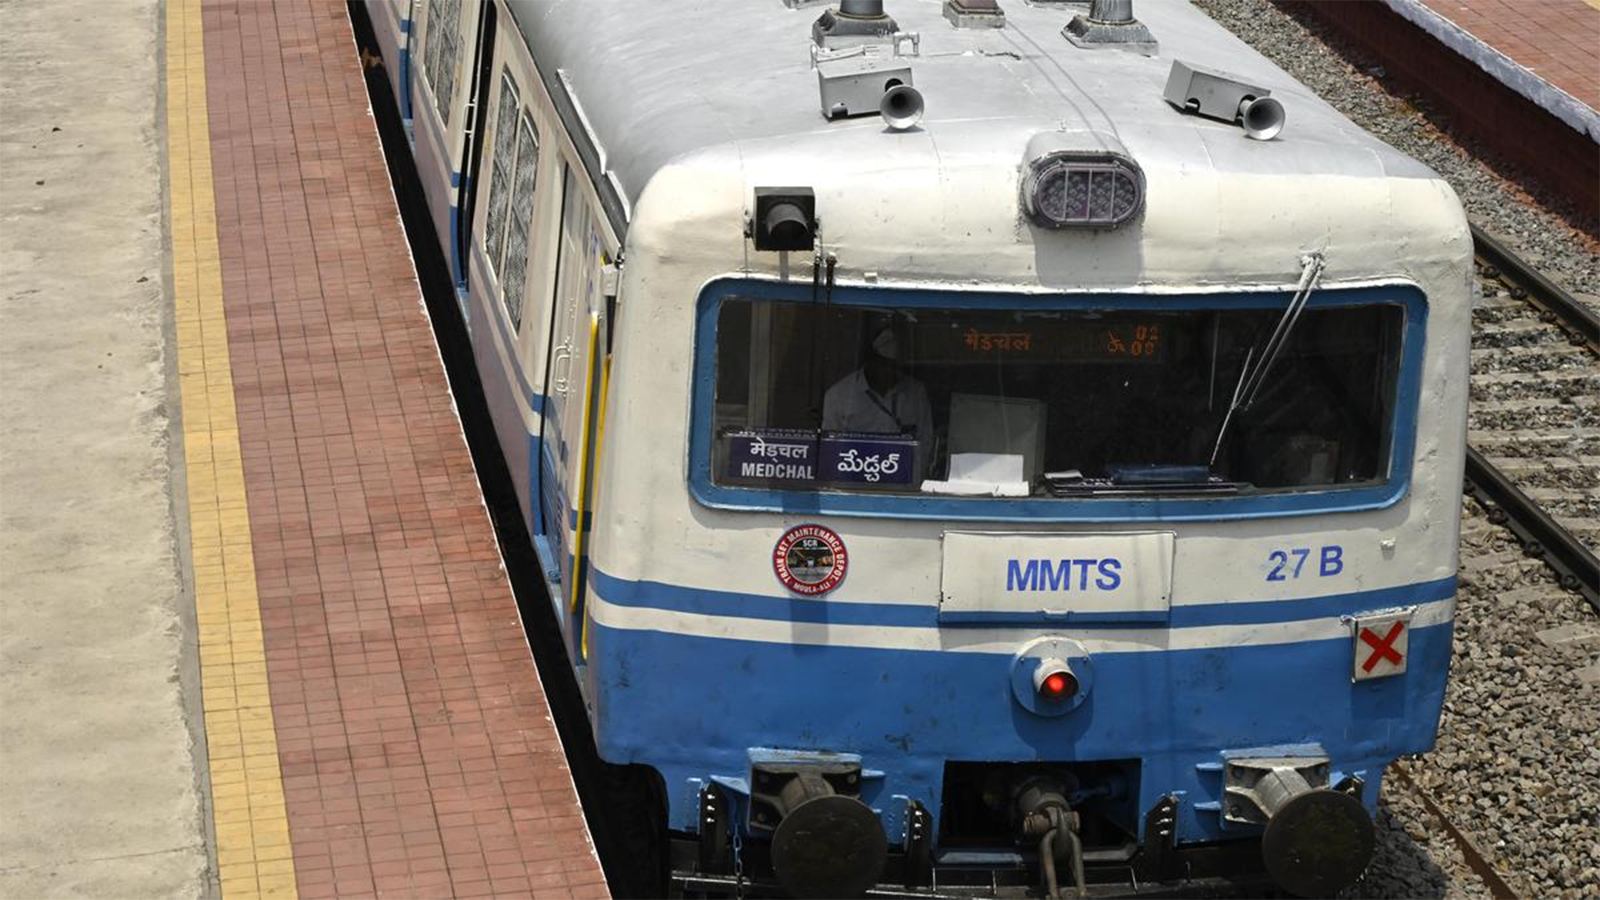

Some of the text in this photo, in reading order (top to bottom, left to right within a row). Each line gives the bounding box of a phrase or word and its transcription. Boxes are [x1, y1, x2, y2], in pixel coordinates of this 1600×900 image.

[741, 462, 815, 480] MEDCHAL
[837, 449, 900, 482] మేడ్చల్
[776, 527, 845, 583] TRAIN SET MAINTENANCE DEPOT
[1266, 545, 1344, 582] 27 B
[1006, 558, 1122, 592] MMTS
